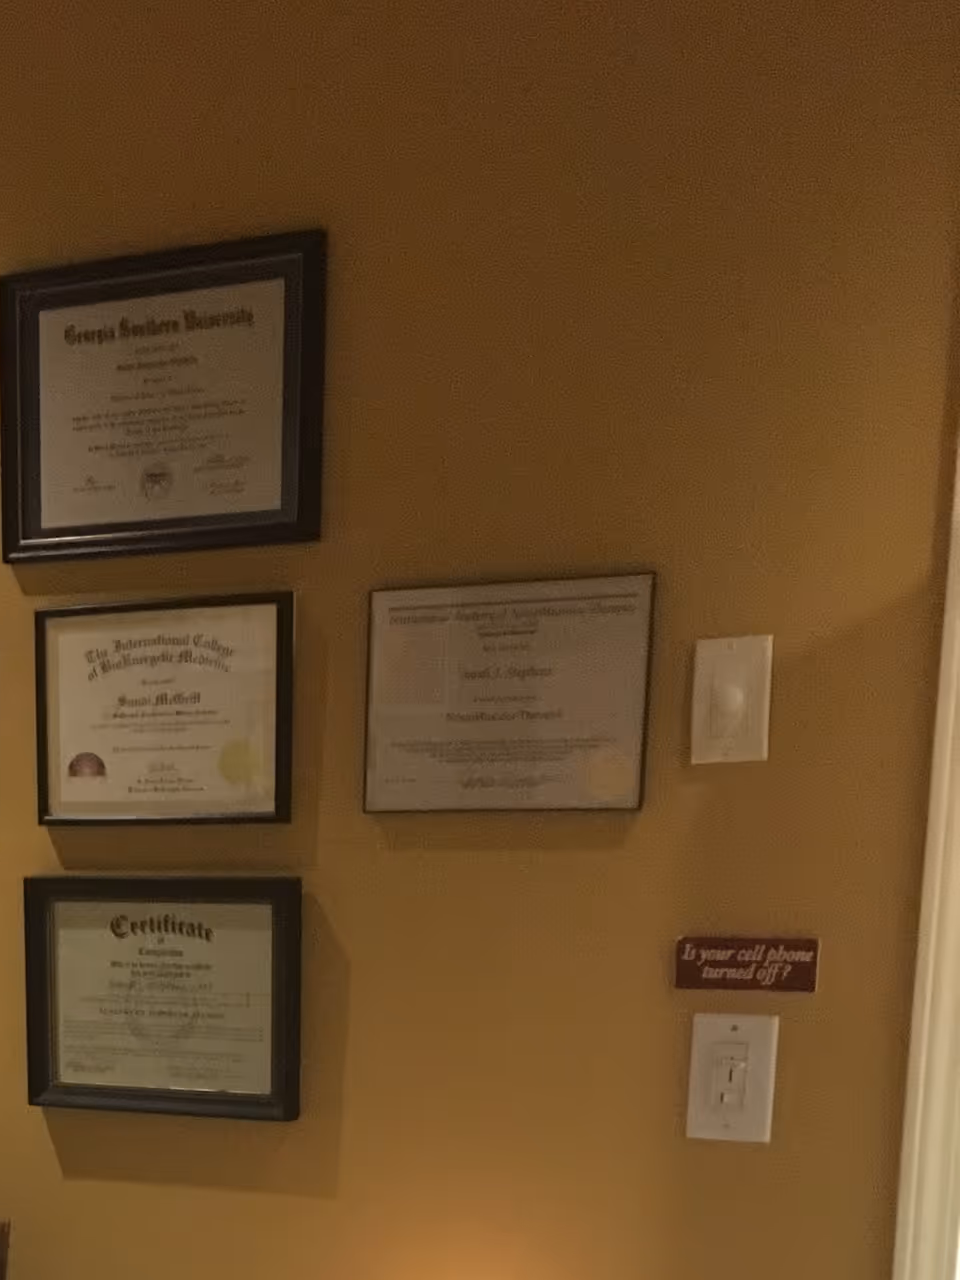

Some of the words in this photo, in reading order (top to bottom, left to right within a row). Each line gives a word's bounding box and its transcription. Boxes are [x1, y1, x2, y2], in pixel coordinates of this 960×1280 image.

[112, 634, 191, 655] International
[192, 633, 233, 658] College
[87, 665, 98, 682] of
[178, 648, 230, 673] Medicine
[109, 912, 214, 943] Certificate
[681, 943, 696, 961] Is
[697, 948, 737, 966] your
[737, 944, 766, 961] cell
[766, 945, 814, 966] phone
[702, 963, 756, 980] turned
